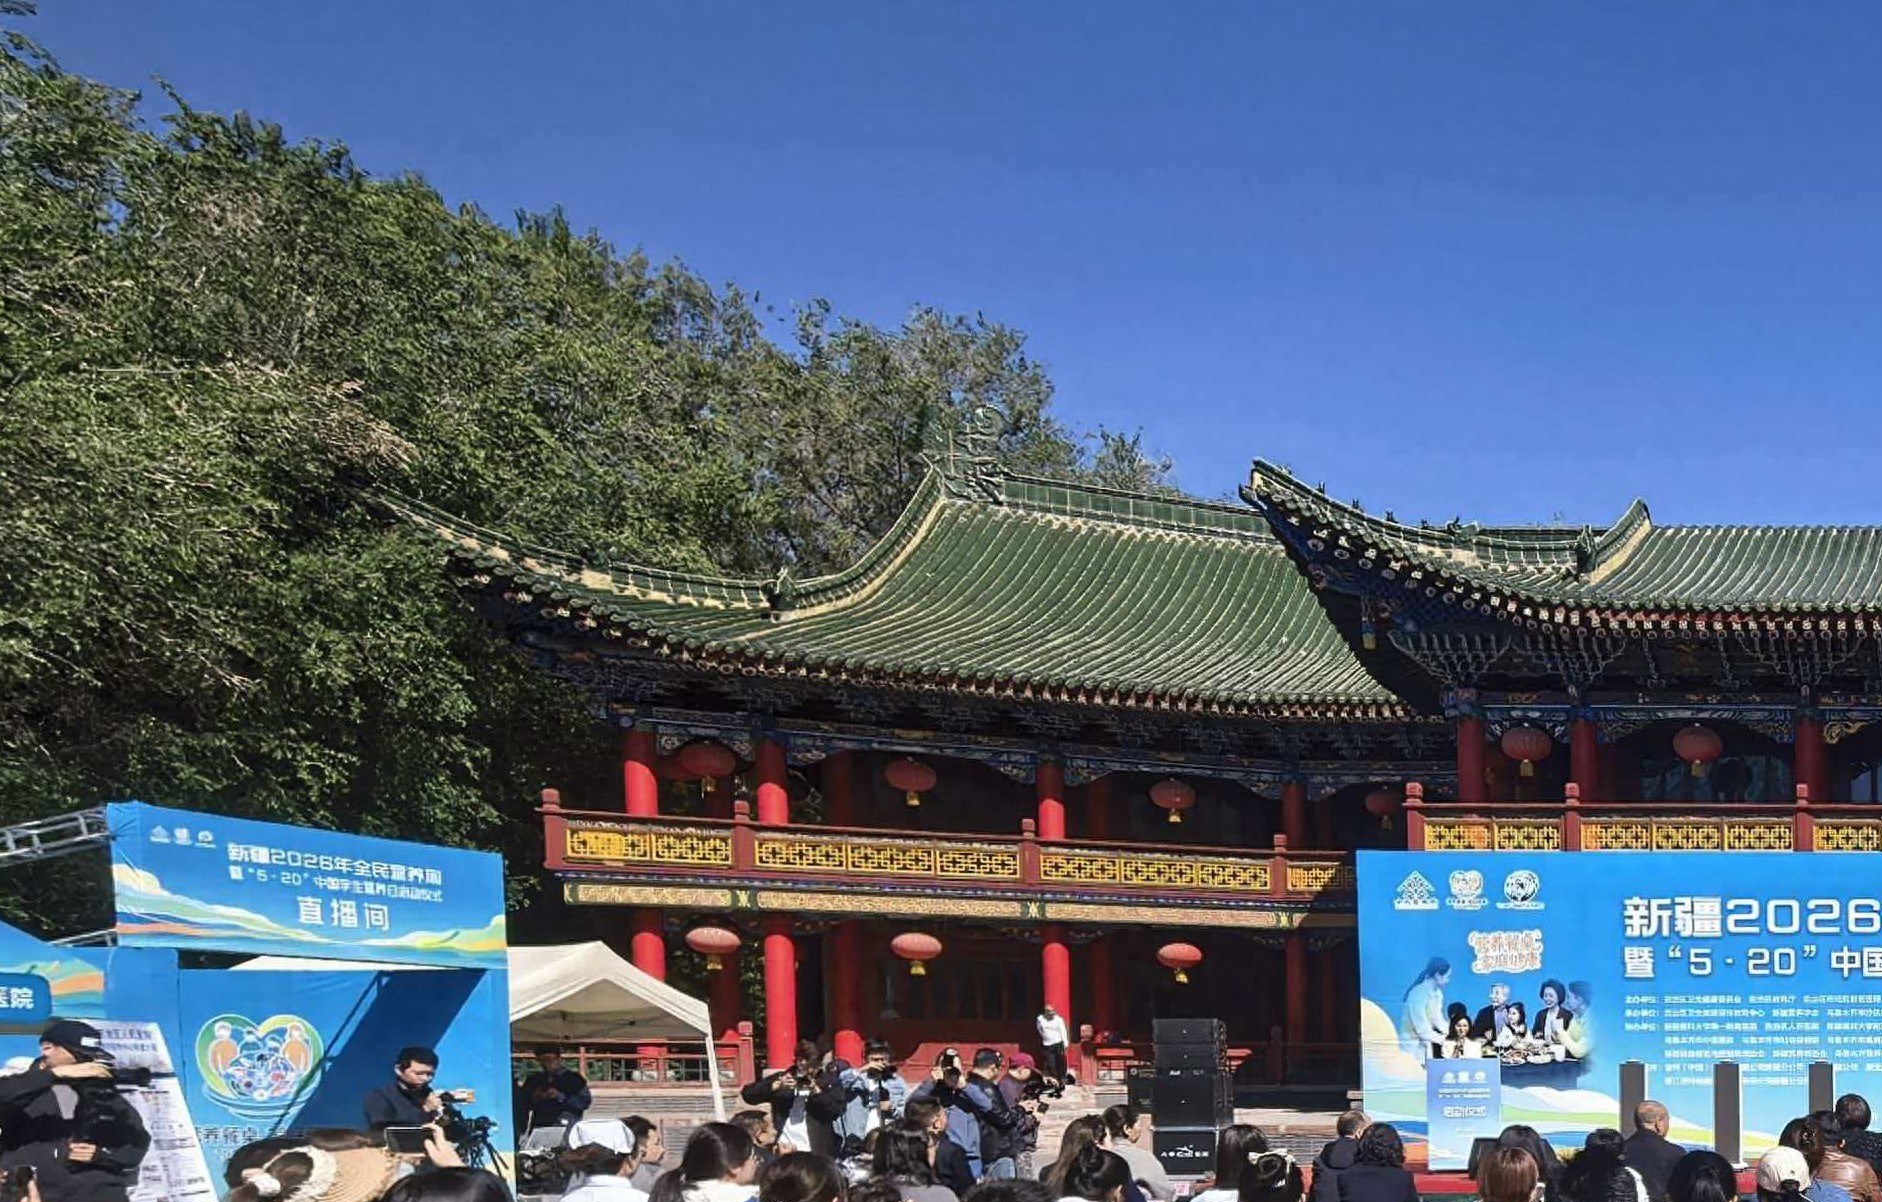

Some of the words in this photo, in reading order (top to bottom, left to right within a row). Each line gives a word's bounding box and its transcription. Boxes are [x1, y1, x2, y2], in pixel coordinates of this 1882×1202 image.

[227, 843, 442, 886] 新疆2026年全民营养周
[296, 896, 390, 932] 直播间
